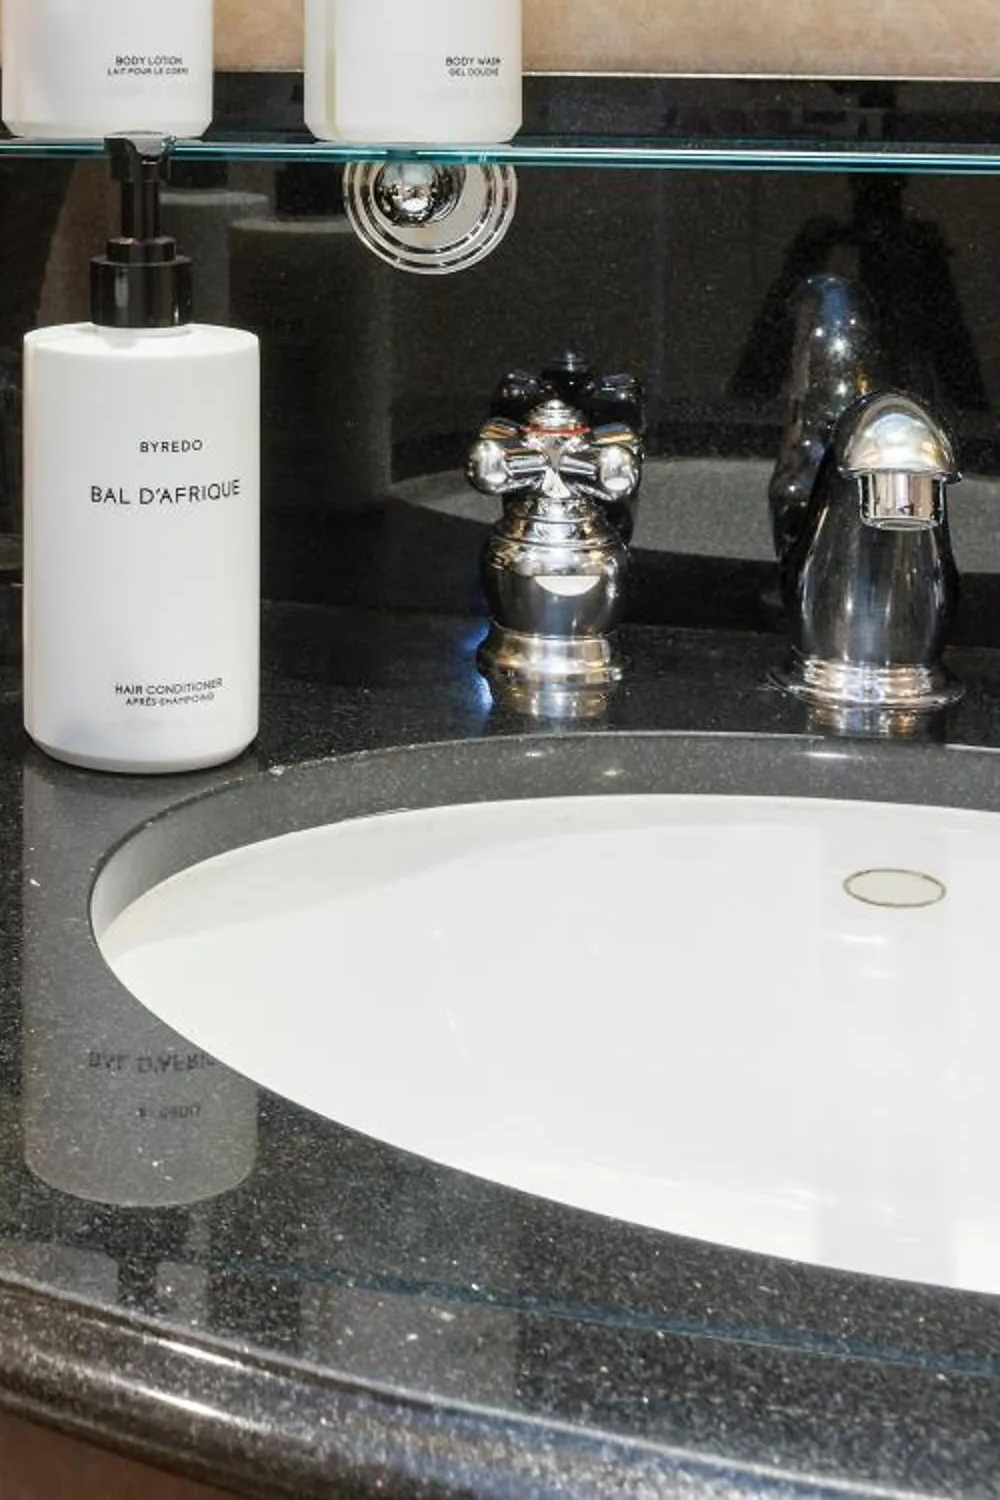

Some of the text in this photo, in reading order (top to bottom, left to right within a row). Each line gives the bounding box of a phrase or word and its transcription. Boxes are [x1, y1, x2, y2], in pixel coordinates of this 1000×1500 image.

[115, 55, 146, 66] BODY
[445, 56, 474, 67] BODY
[139, 439, 204, 453] BYREDO
[91, 479, 241, 505] BAL D'AFRIQUE
[115, 677, 223, 696] HAIR CONDITIONER
